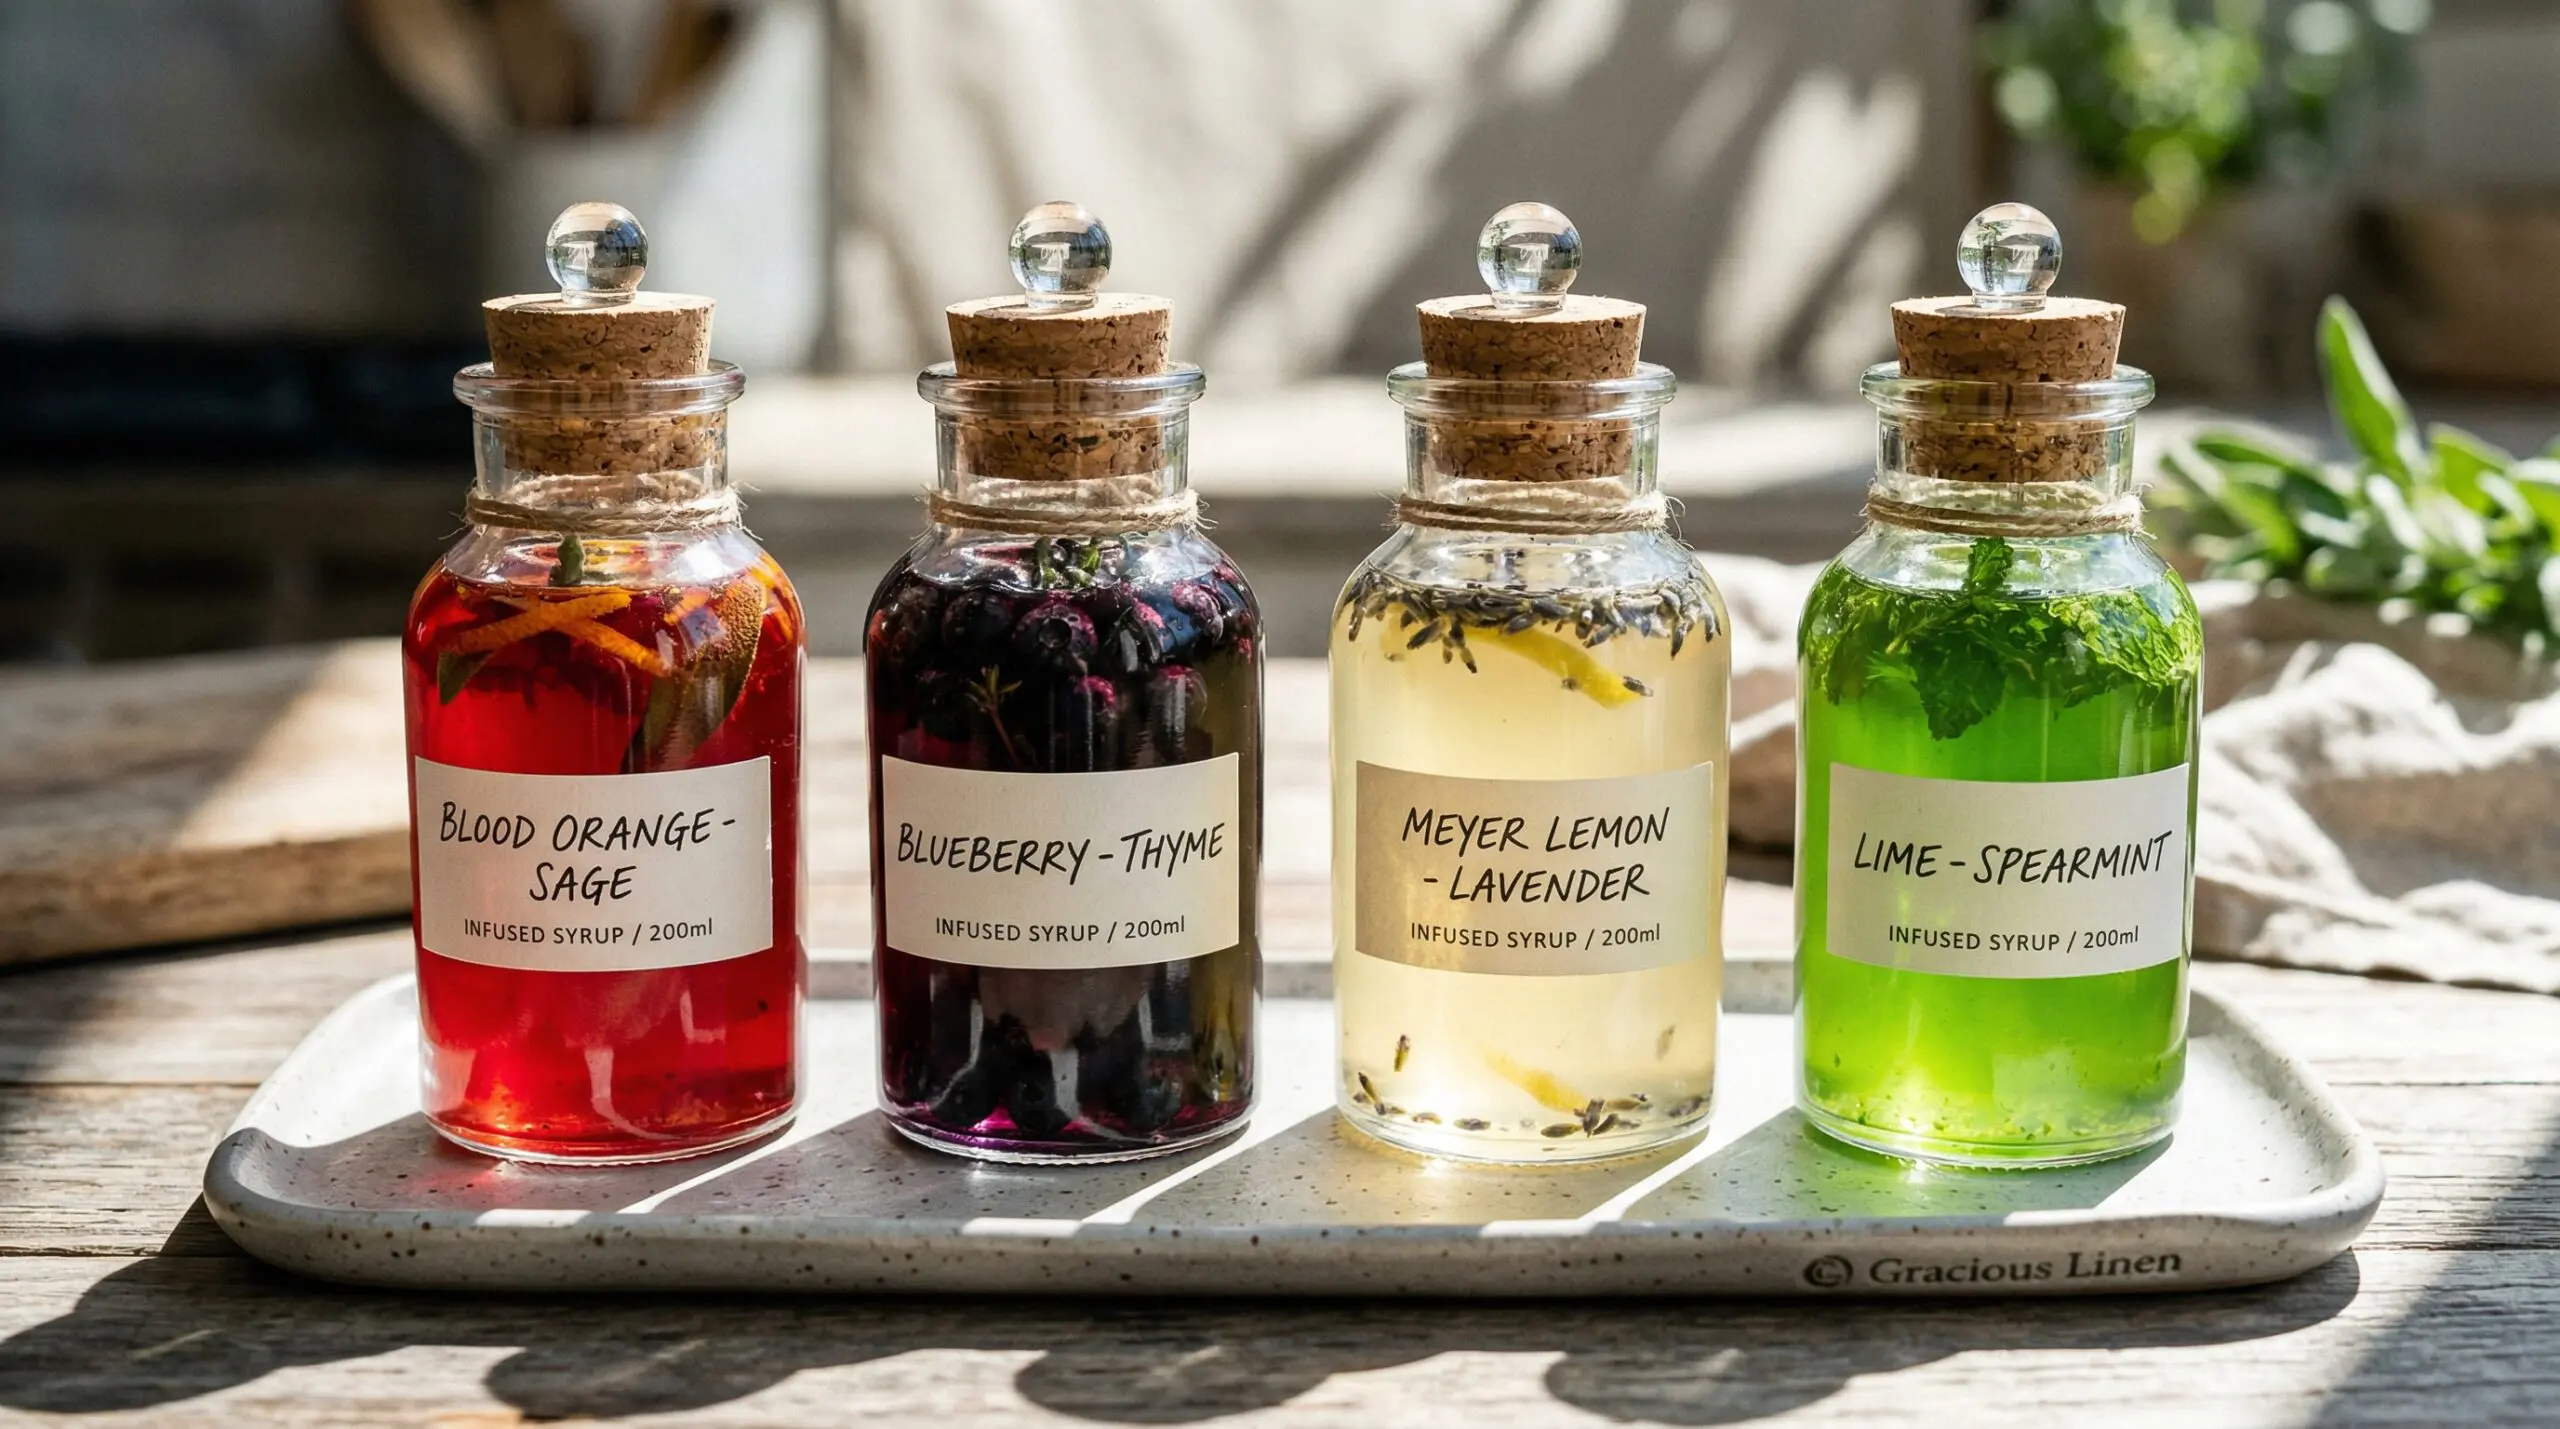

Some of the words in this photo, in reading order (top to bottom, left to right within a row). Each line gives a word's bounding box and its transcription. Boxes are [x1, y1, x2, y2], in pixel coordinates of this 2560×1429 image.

[440, 801, 536, 849] BLOOD
[1402, 807, 1529, 857] MEYER
[1545, 807, 1670, 852] LEMON
[529, 862, 637, 905] SAGE
[464, 918, 545, 943] INFUSED
[553, 927, 624, 944] SYRUP
[632, 924, 642, 946] /
[649, 918, 713, 941] 200ml
[936, 918, 1021, 941] INFUSED
[1029, 924, 1099, 942] SYRUP
[1107, 922, 1117, 943] /
[1124, 915, 1185, 939] 200ml
[1411, 923, 1499, 947] INFUSED
[1507, 929, 1577, 949] SYRUP
[1585, 929, 1595, 950] /
[1602, 924, 1660, 946] 200ml
[1889, 925, 1981, 949] INFUSED
[1989, 933, 2060, 951] SYRUP
[2067, 931, 2077, 953] /
[2083, 926, 2139, 949] 200ml
[1869, 1257, 2053, 1284] Gracious
[2065, 1251, 2182, 1278] Linen
